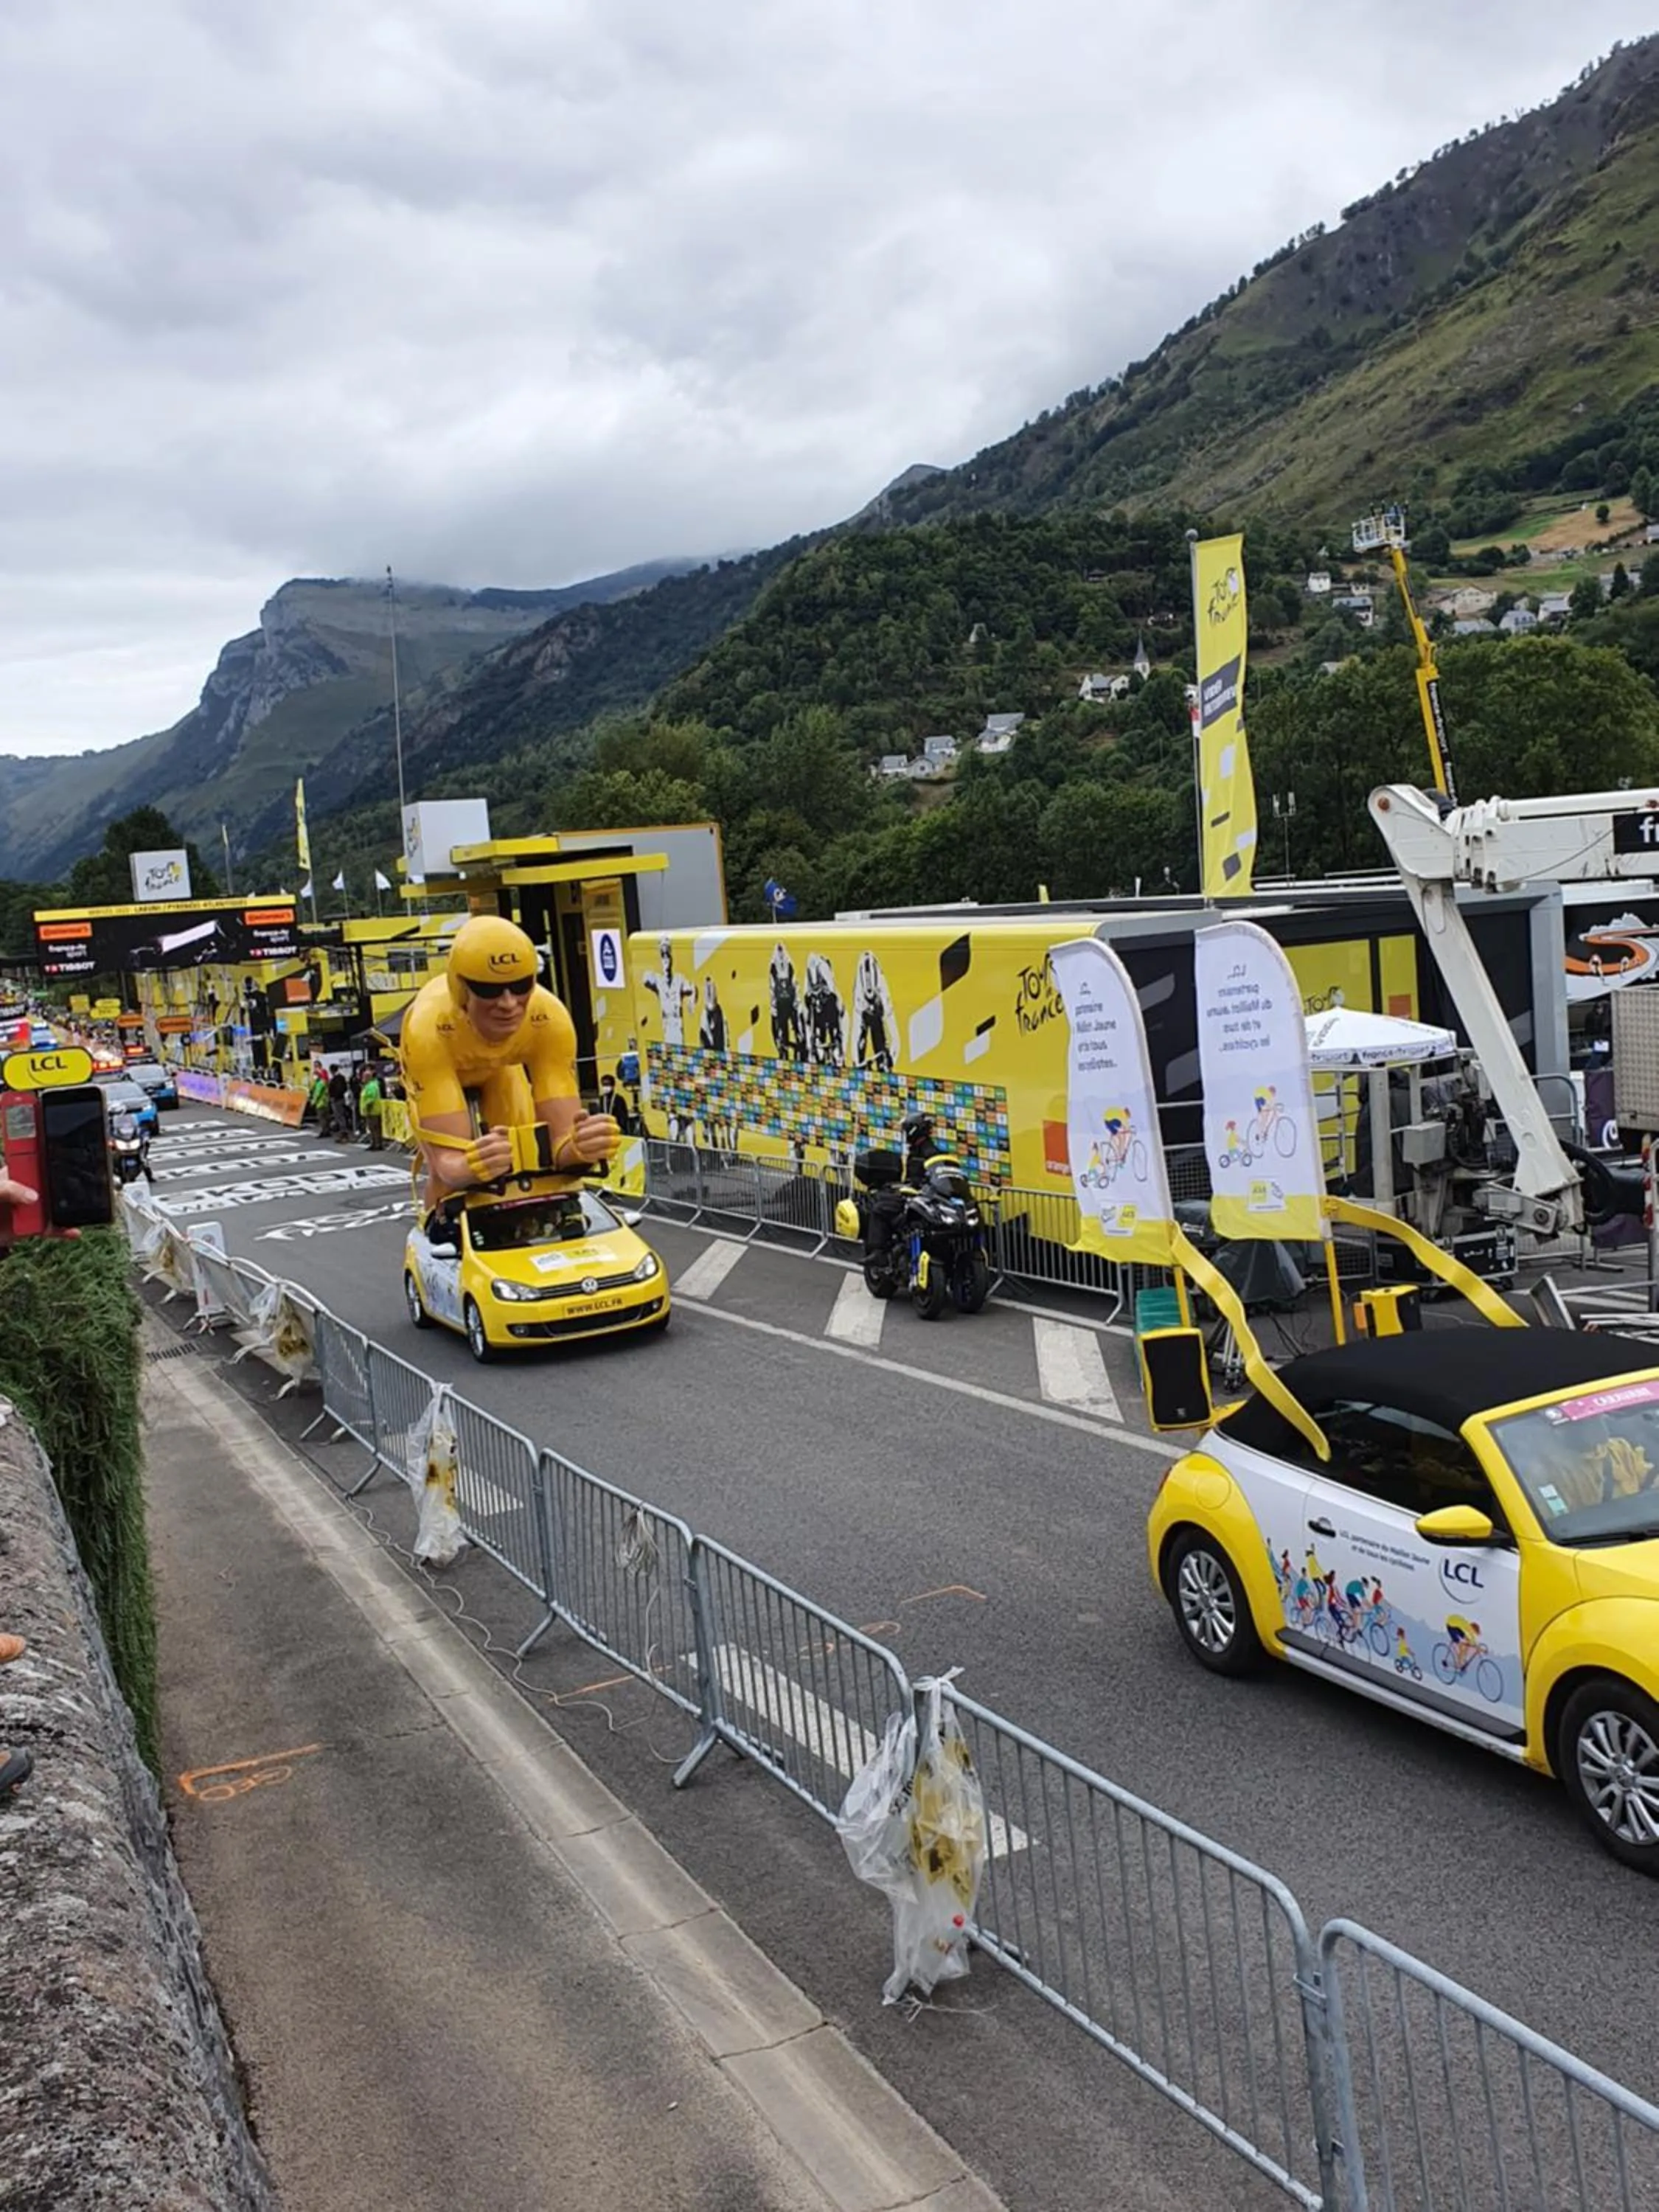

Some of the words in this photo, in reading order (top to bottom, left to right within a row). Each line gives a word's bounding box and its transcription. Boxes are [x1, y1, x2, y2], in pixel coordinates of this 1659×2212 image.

[490, 953, 521, 966] LCL
[530, 1014, 551, 1022] LCL
[30, 1056, 68, 1072] LCL
[1443, 1558, 1485, 1589] LCL
